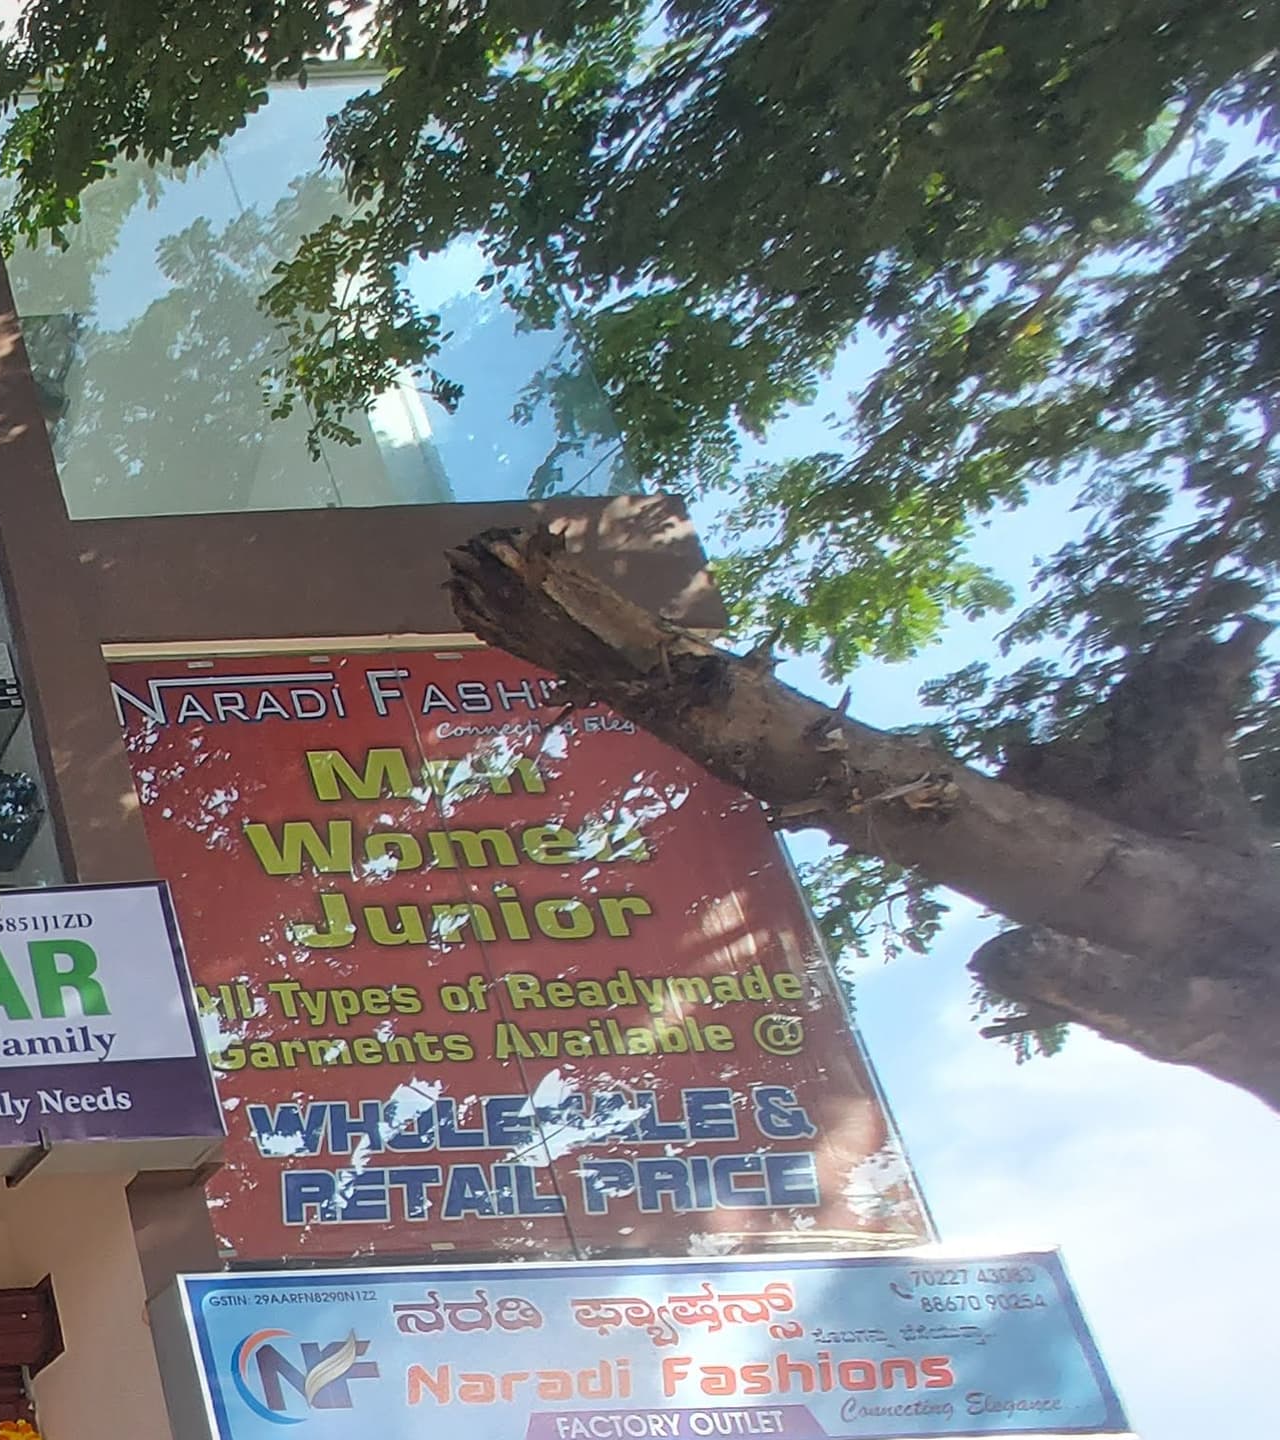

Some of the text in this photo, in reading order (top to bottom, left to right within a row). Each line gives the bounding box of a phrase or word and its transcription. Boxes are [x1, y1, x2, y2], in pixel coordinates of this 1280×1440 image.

[110, 672, 346, 726] NARADI
[583, 716, 637, 735] Eleg
[294, 885, 654, 949] Junior
[268, 980, 423, 1026] Types
[439, 975, 489, 1012] of
[509, 966, 804, 1015] Readymade
[495, 1016, 734, 1062] Available
[754, 1014, 805, 1056] @
[40, 1085, 133, 1116] Needs
[752, 1084, 818, 1140] &
[280, 1151, 822, 1226] RETAIL PRICE
[209, 1294, 250, 1308] GSTIN:
[406, 1350, 954, 1406] Naradi Fashions
[556, 1409, 784, 1440] FACTORY OUTLET
[841, 1391, 1064, 1423] Connecting Elegance
